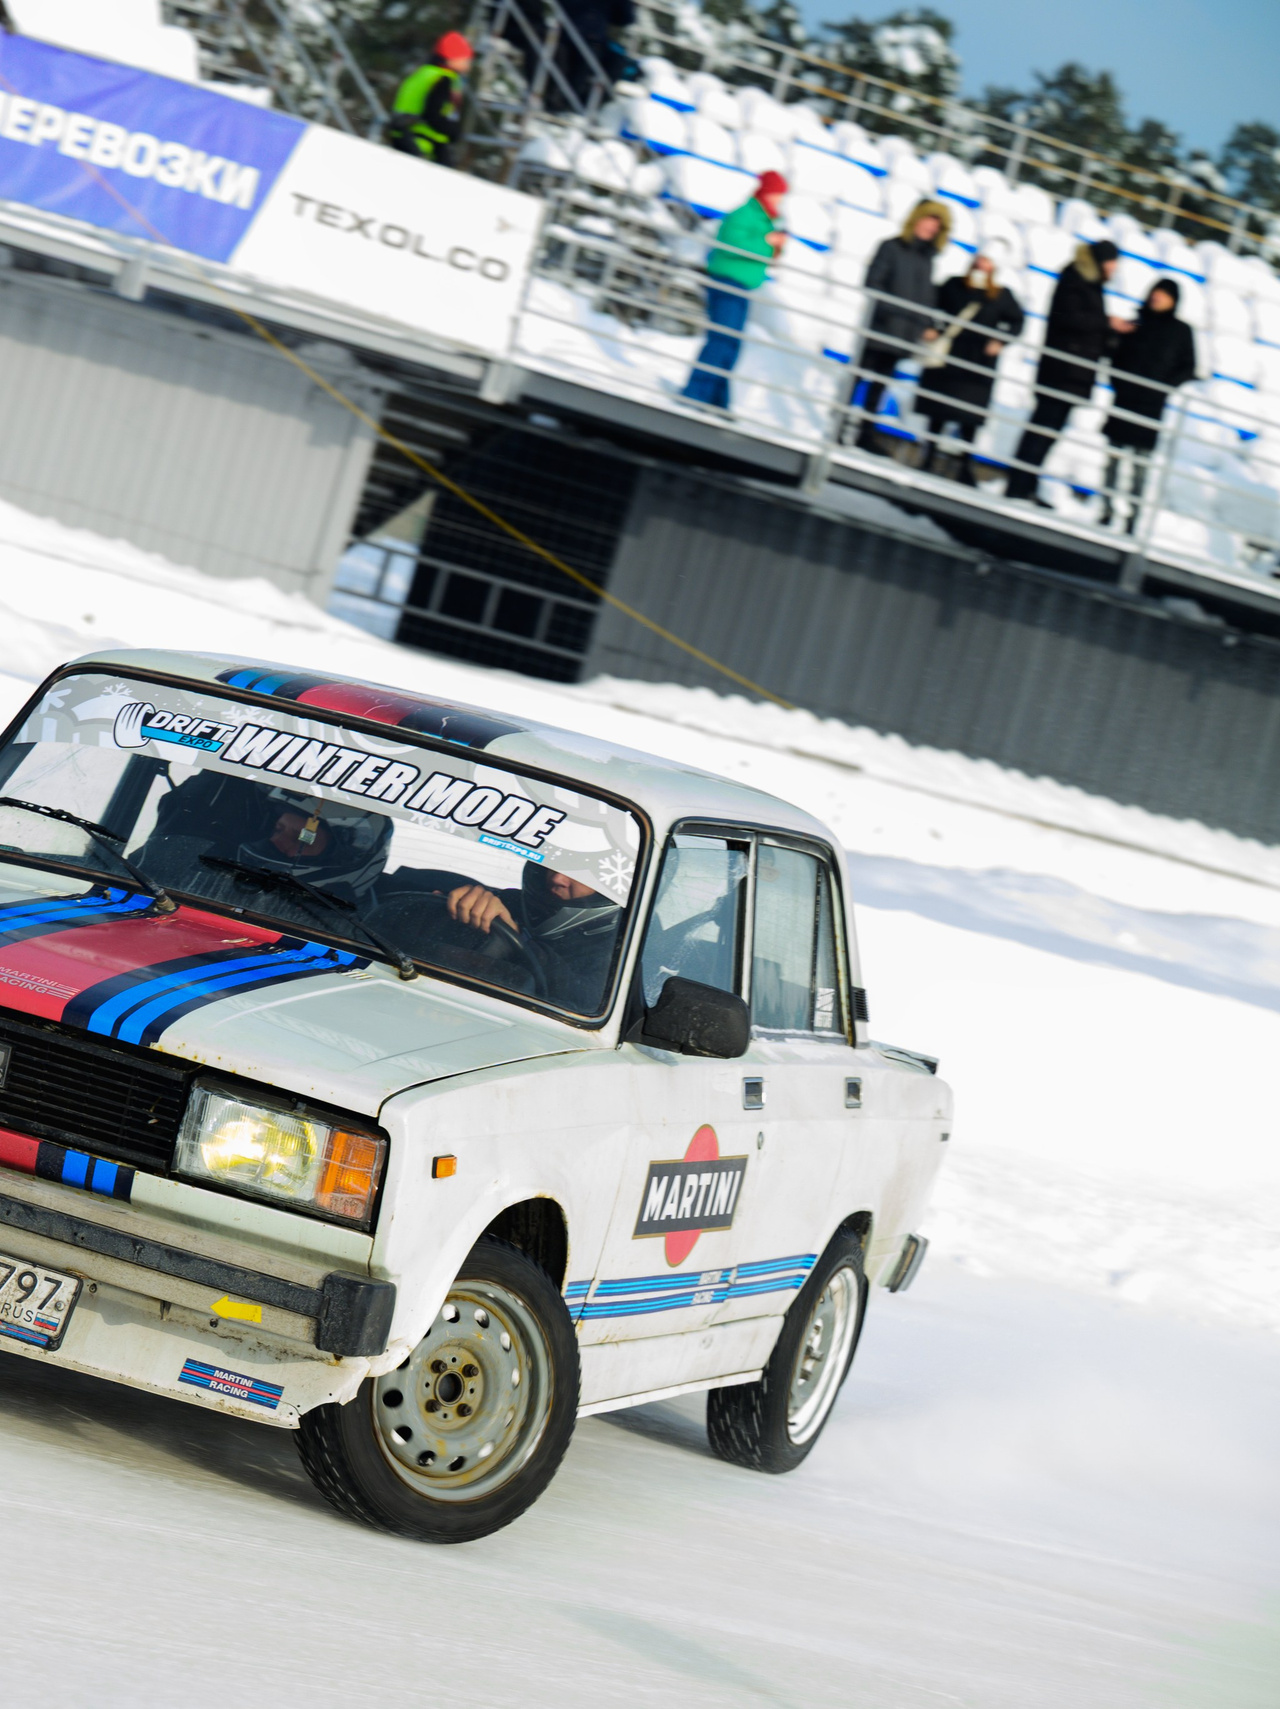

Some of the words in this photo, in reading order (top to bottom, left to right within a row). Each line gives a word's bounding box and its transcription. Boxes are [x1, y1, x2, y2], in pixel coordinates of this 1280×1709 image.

[291, 192, 511, 283] TEXOL.CO
[146, 710, 238, 742] DRIFT
[179, 735, 213, 748] EXPO
[221, 724, 419, 804] WINTER
[404, 772, 566, 848] MODE
[642, 1171, 741, 1221] MARTINI
[0, 1302, 34, 1323] RUS
[208, 1380, 248, 1398] RACING
[213, 1370, 253, 1387] MARTINI
